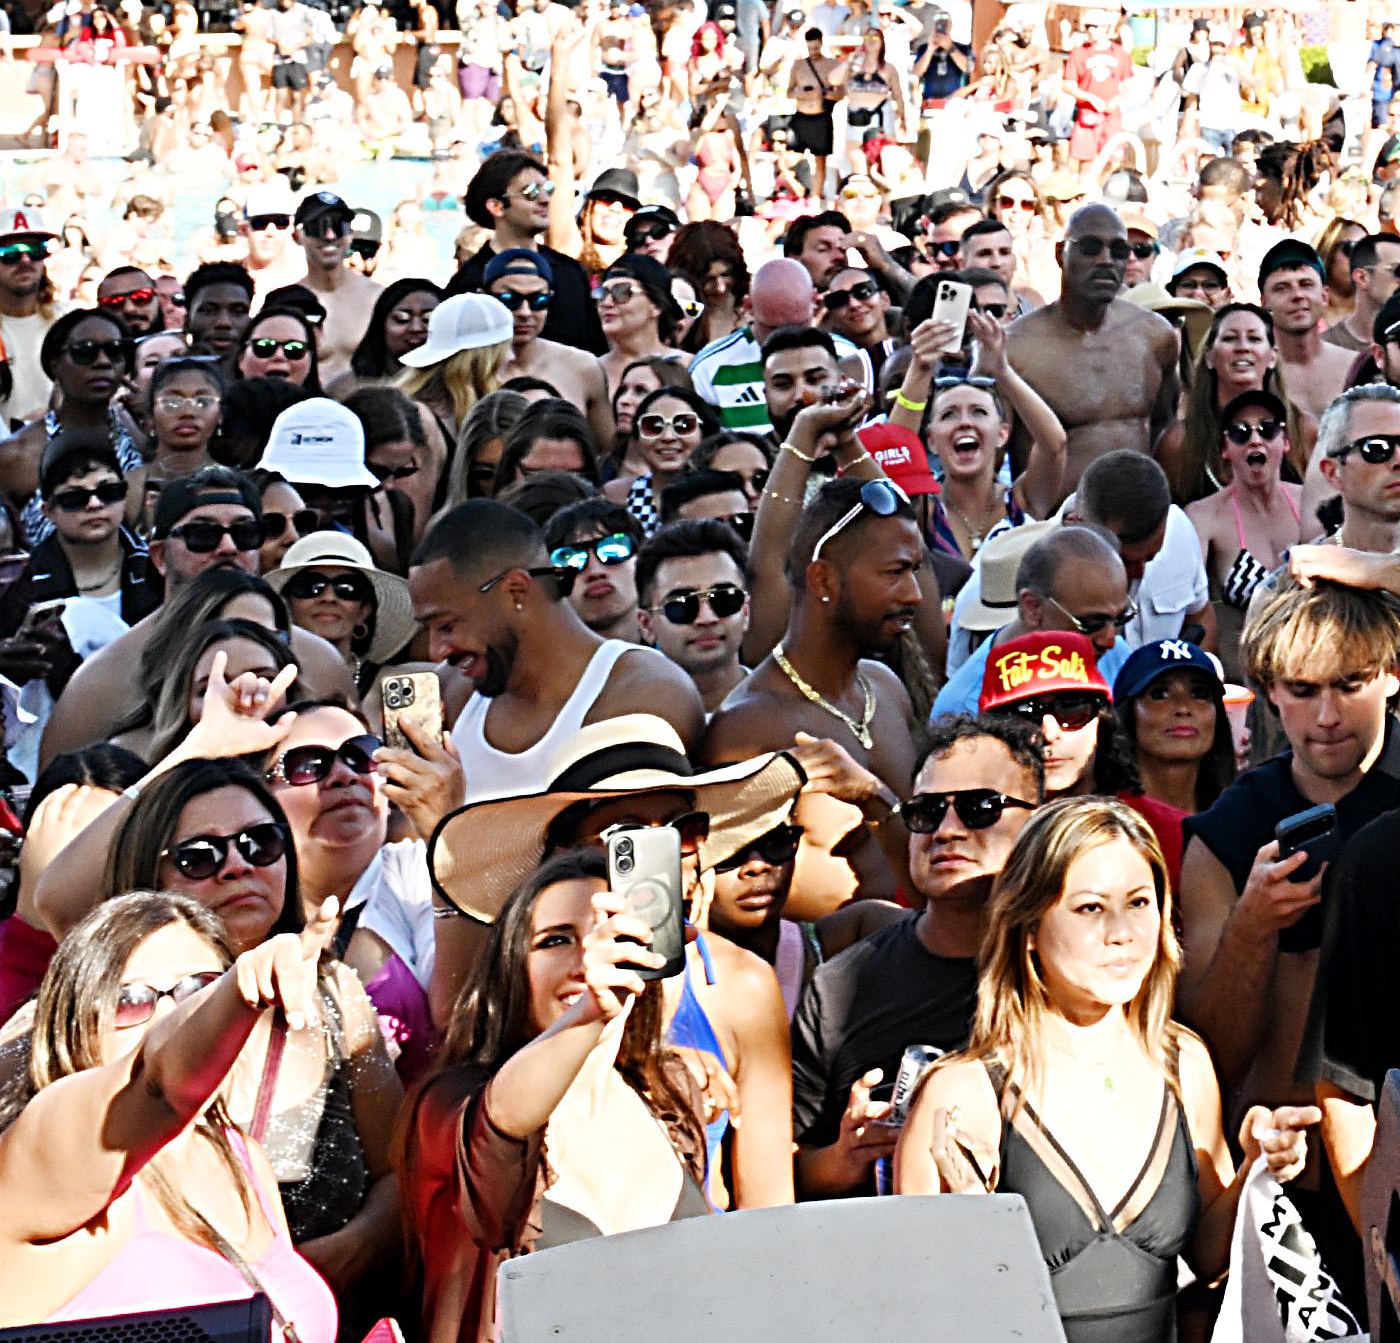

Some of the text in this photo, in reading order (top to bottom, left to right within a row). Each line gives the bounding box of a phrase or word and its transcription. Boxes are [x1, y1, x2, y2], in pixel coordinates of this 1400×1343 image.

[13, 211, 30, 230] A
[1159, 639, 1192, 659] NY
[995, 651, 1038, 691] Fat
